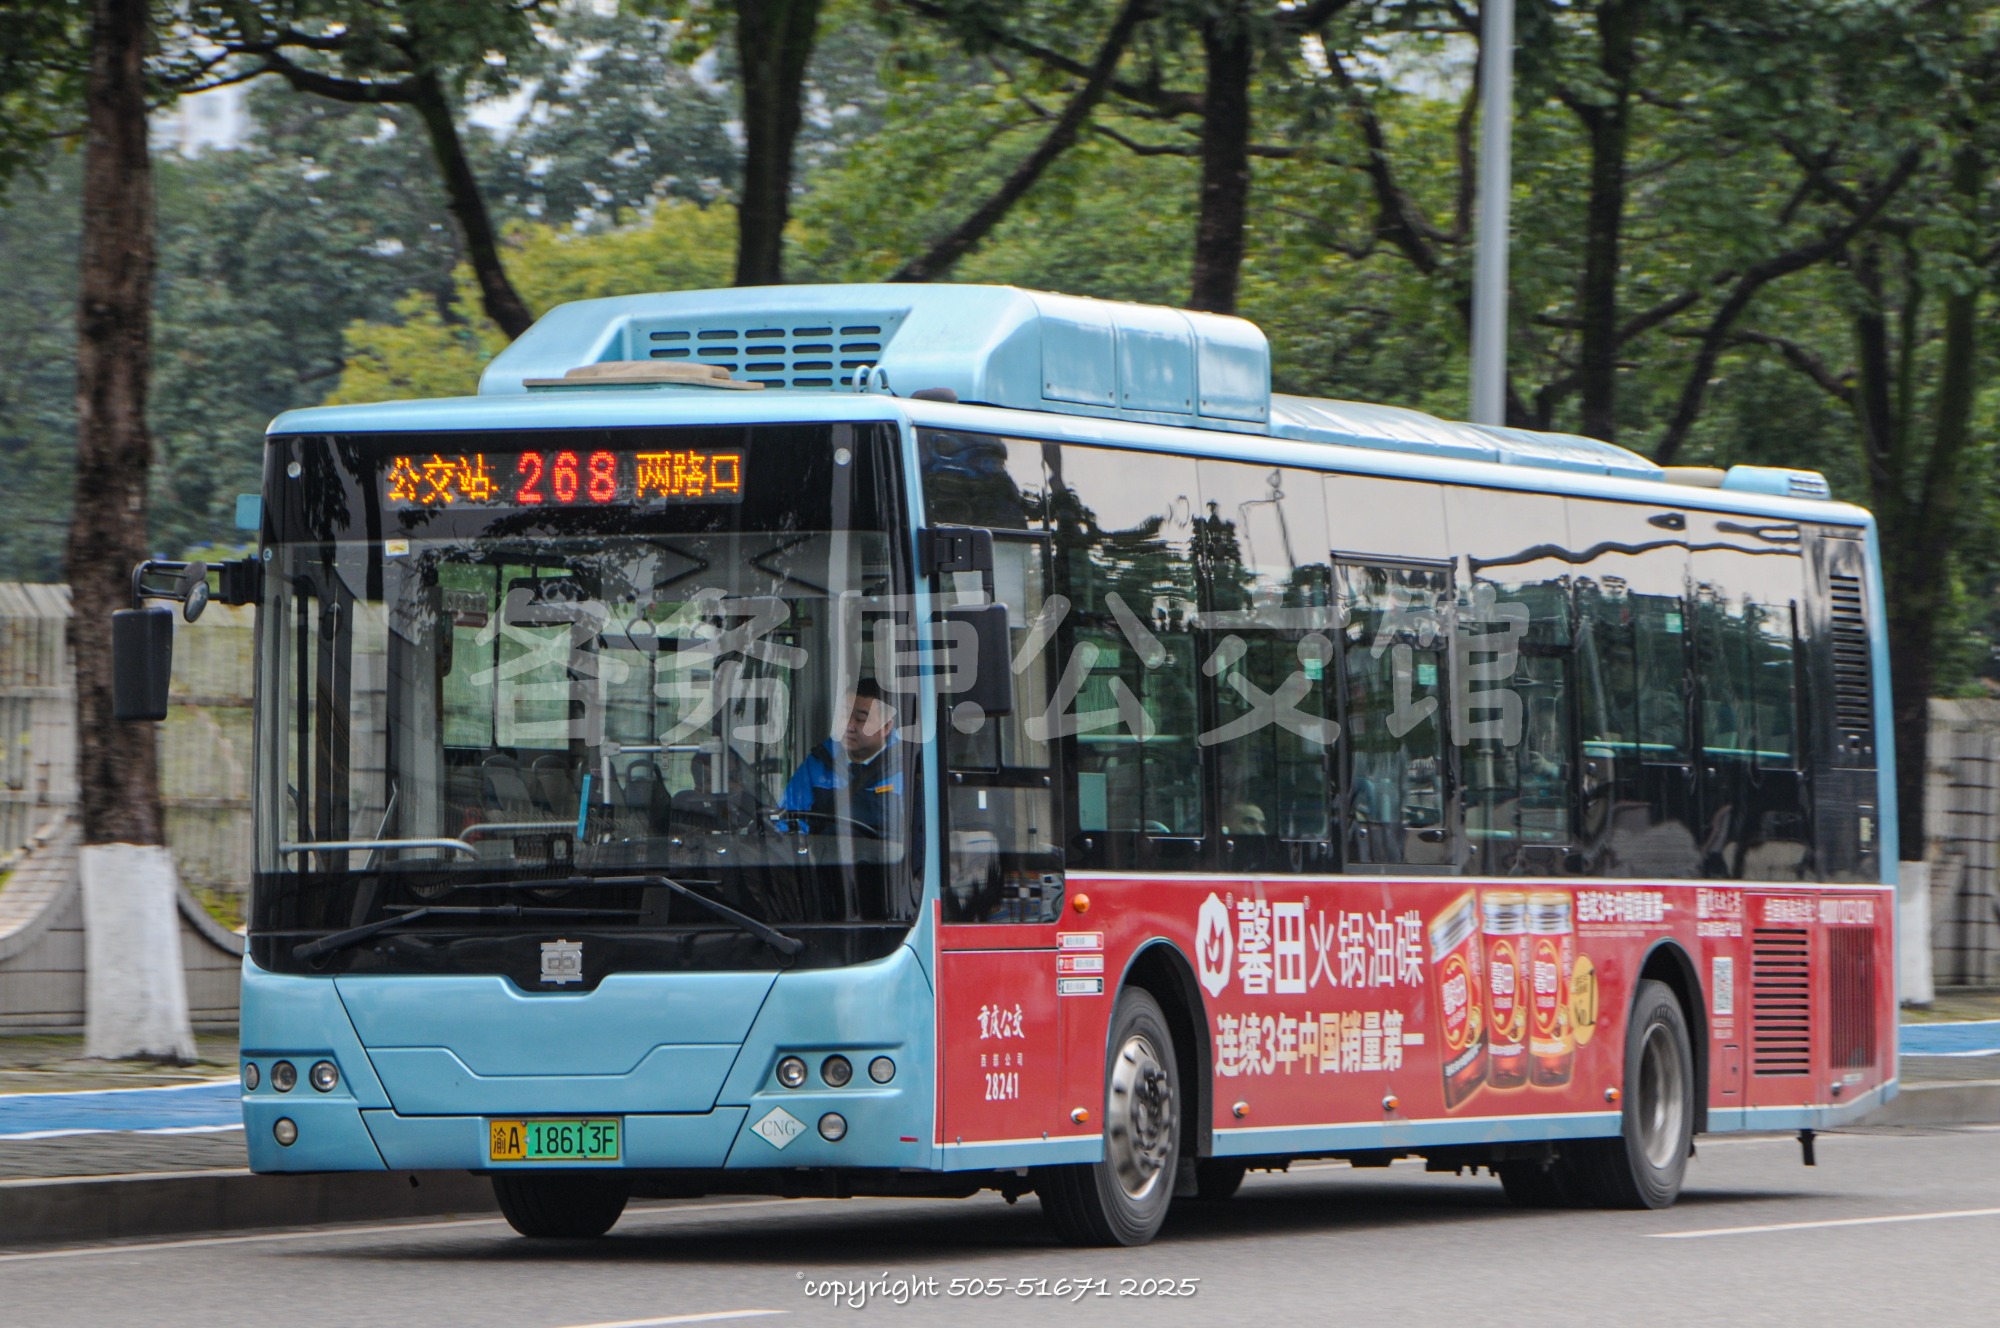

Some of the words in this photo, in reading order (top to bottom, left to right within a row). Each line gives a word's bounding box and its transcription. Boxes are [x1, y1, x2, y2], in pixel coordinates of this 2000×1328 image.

[387, 453, 491, 503] 公交站
[517, 451, 616, 503] 268
[636, 451, 740, 498] 两路口
[977, 1004, 1025, 1039] 重庆公交
[1215, 1009, 1424, 1078] 连续3年中国销量第一
[985, 1072, 1019, 1101] 28241
[761, 1119, 797, 1137] CNG
